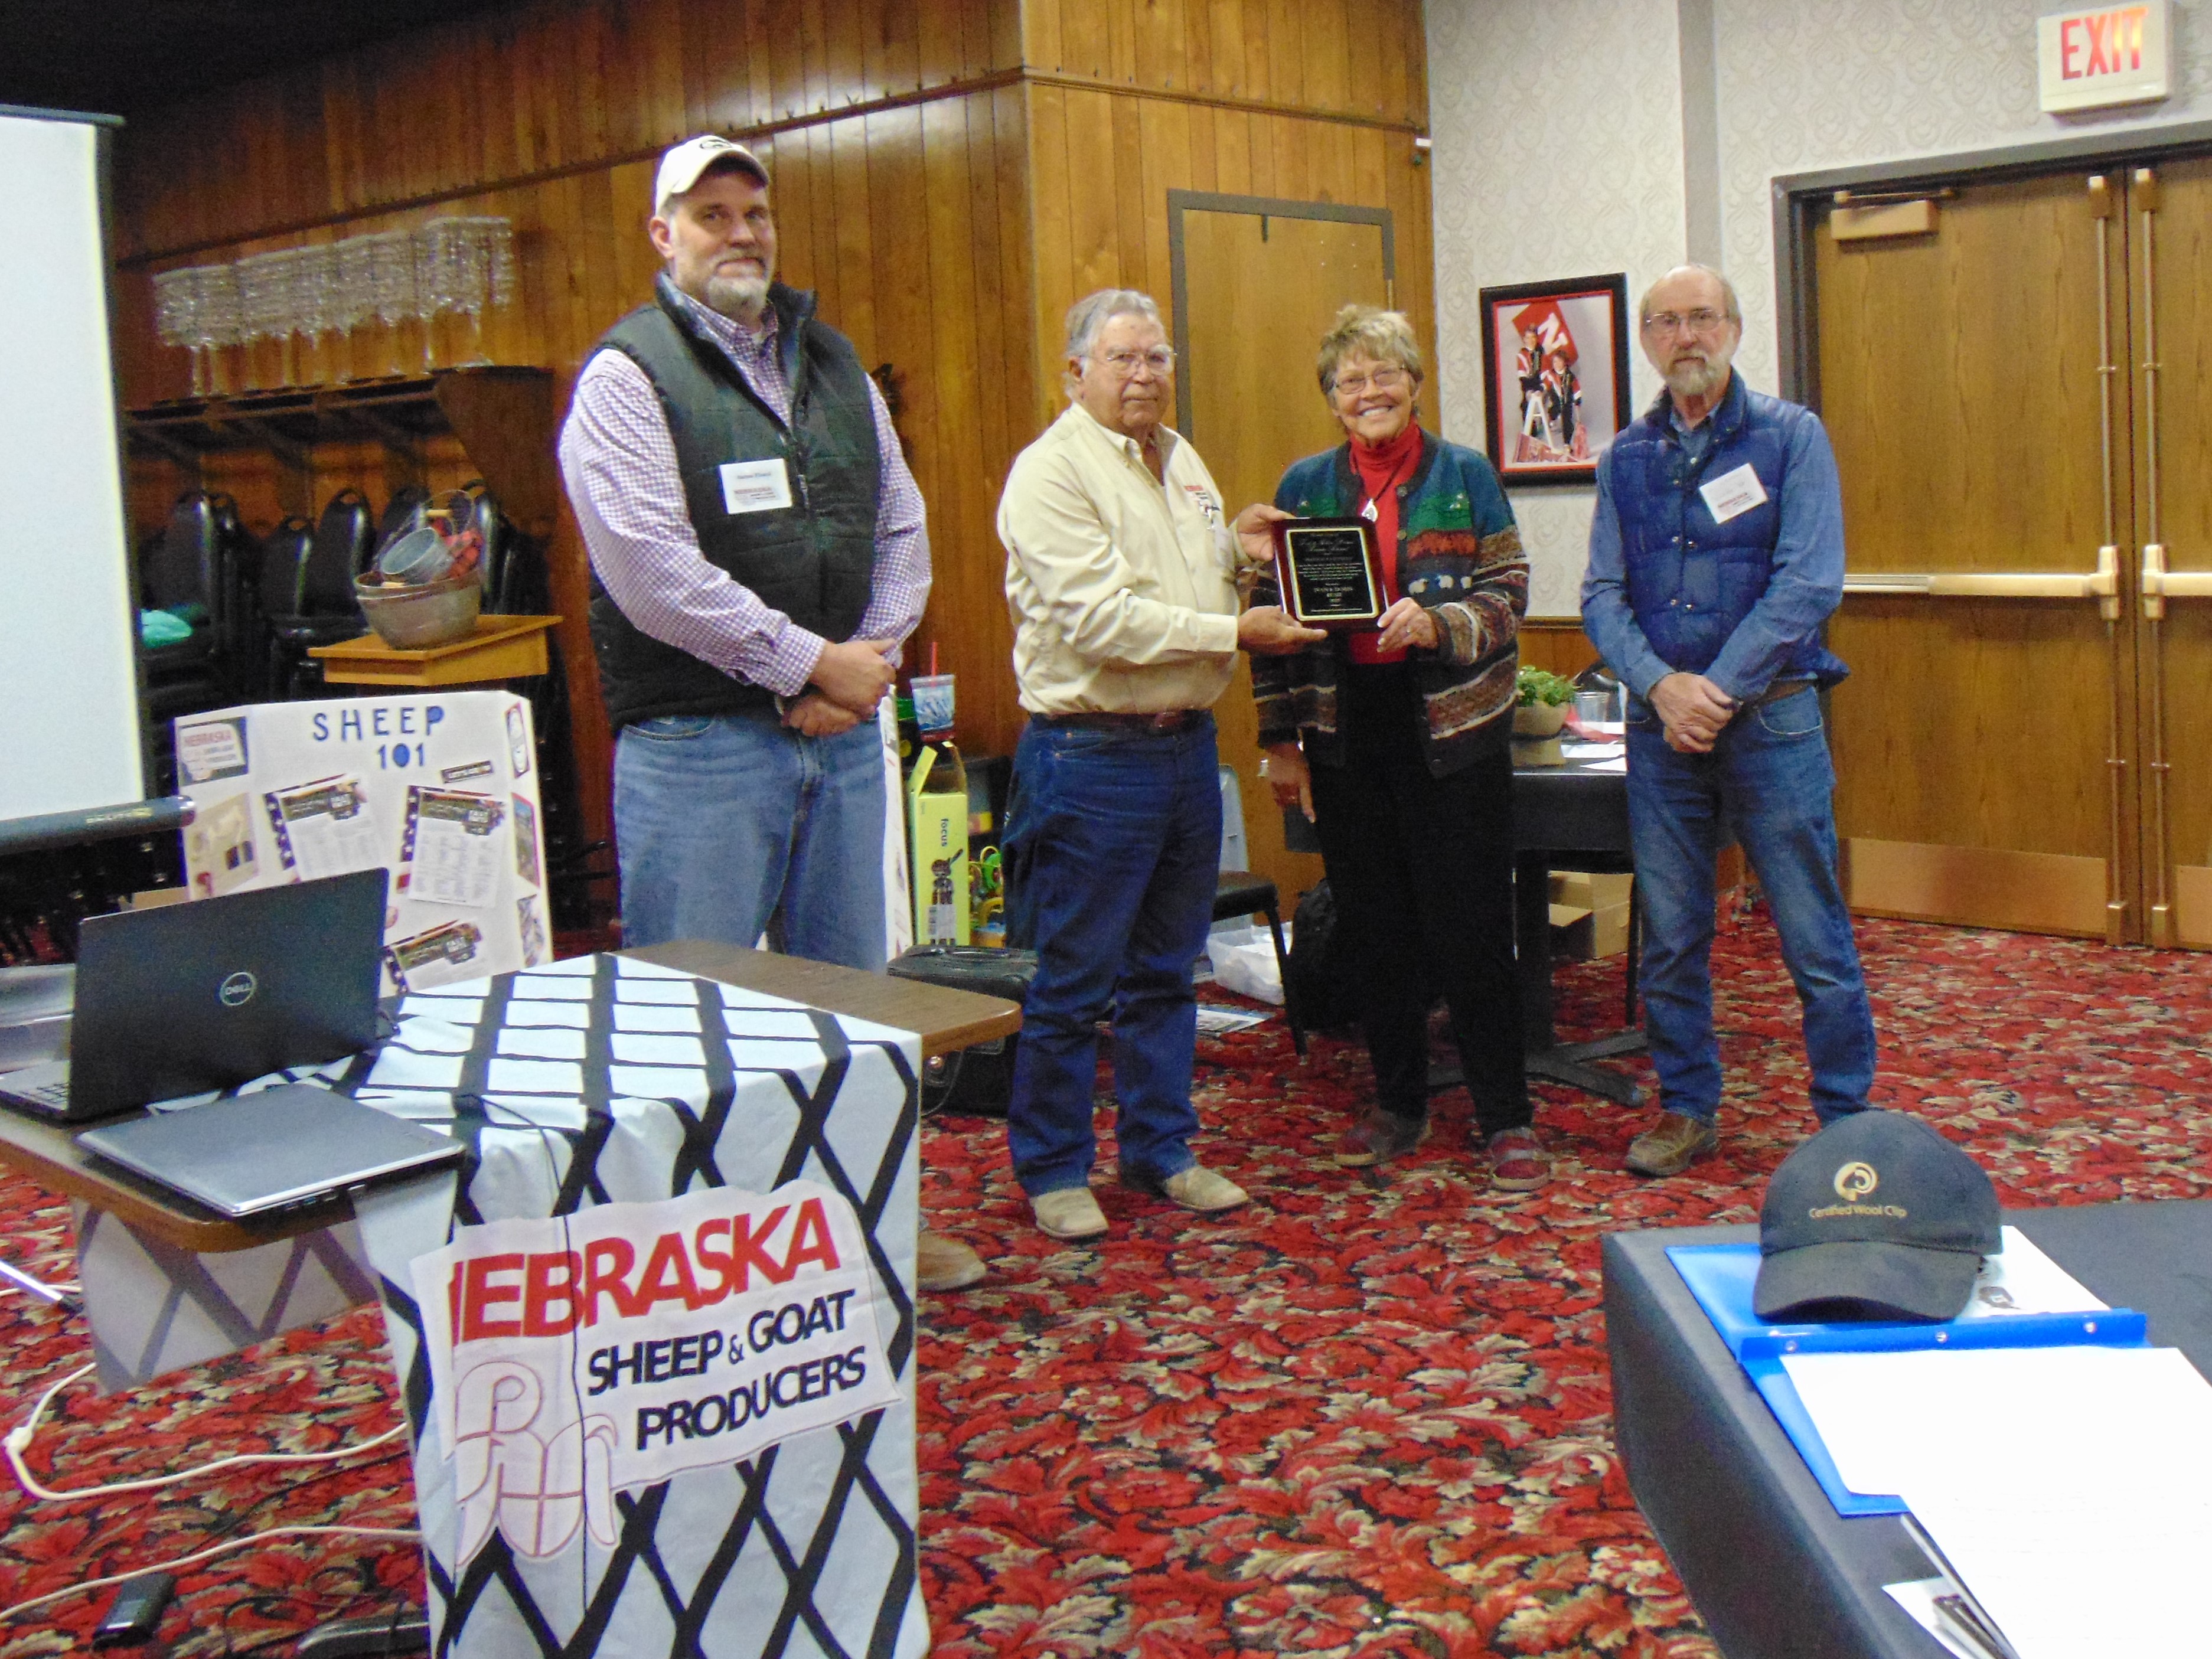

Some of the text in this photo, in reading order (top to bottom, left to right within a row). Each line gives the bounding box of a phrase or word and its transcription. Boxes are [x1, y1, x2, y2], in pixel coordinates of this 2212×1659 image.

[2060, 5, 2149, 80] EXIT
[312, 706, 445, 742] SHEEP
[377, 742, 426, 769] 101
[941, 818, 949, 847] focus
[225, 984, 251, 995] DELL
[1809, 1204, 1907, 1219] Certified Wool Clip
[588, 1289, 856, 1396] SHEEP & GOAT
[636, 1346, 866, 1451] PRODUCERS
